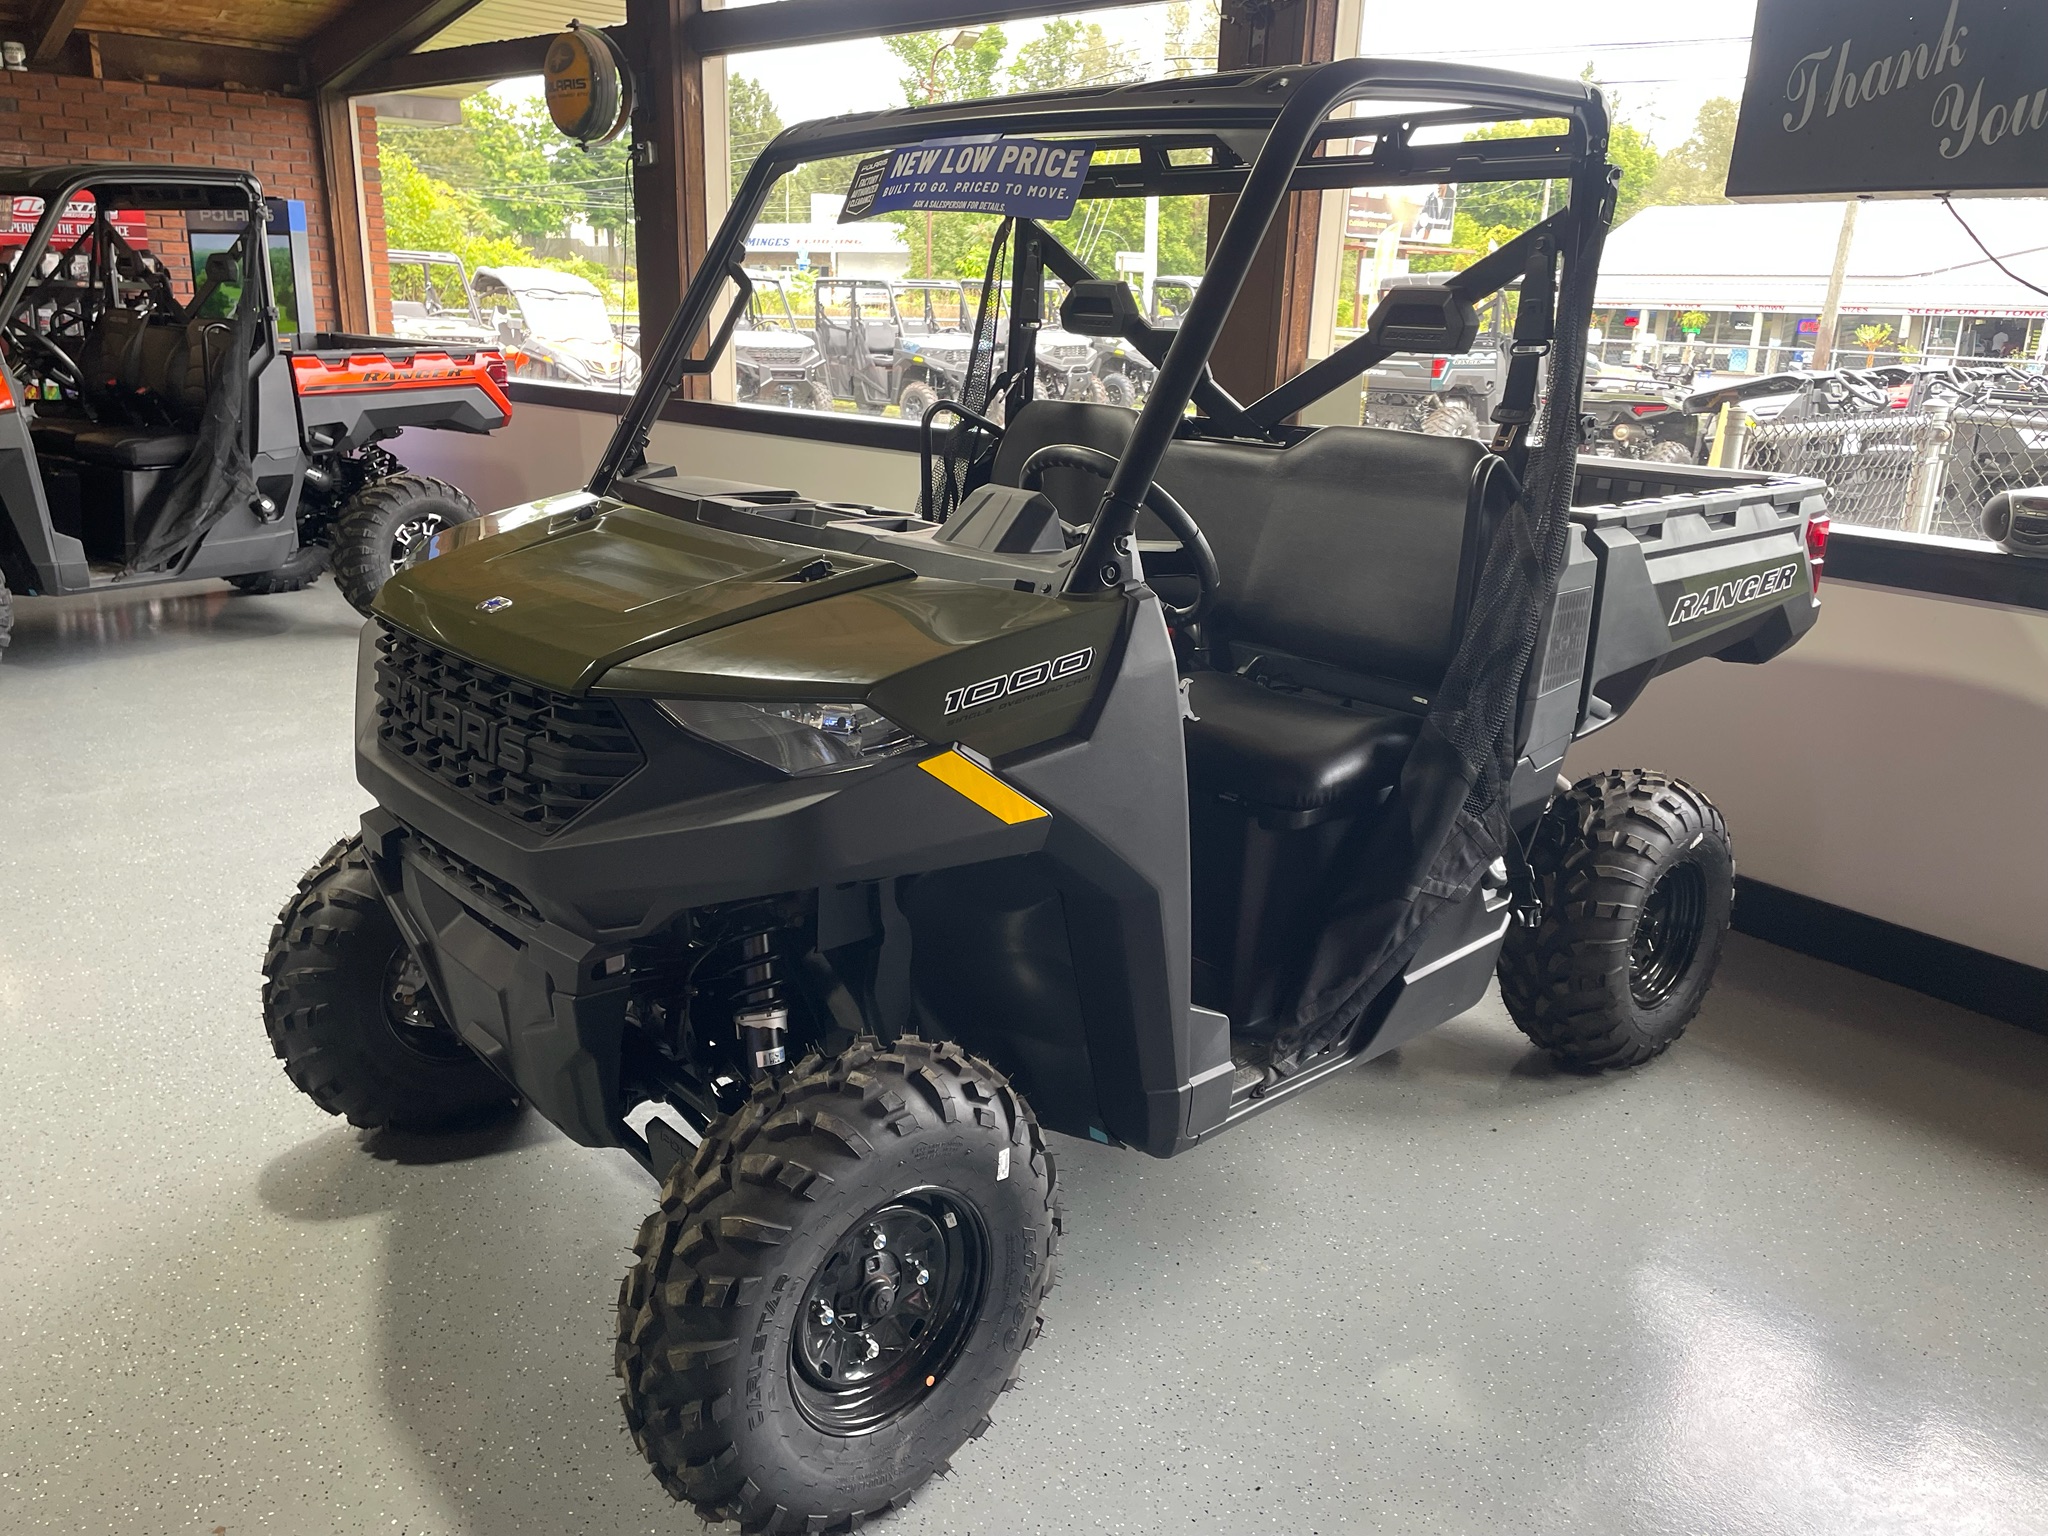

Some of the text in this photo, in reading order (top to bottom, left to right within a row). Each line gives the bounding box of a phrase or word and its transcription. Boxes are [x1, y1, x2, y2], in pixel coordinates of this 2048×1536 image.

[1782, 0, 1968, 132] Thank
[1931, 77, 2048, 159] You
[861, 158, 888, 172] POLARIS
[890, 146, 1085, 178] NEW LOW PRICE
[850, 183, 880, 199] AUTHORIZED
[858, 174, 880, 187] FACTORY
[882, 182, 1069, 200] BUILT TO GO. PRICED TO MOVE.
[912, 200, 924, 208] ASK
[928, 200, 966, 209] SALESPERSON
[979, 202, 1006, 212] DETAILS.
[57, 224, 74, 234] THE
[363, 368, 463, 382] RANGER
[1667, 563, 1798, 626] RANGER
[943, 646, 1097, 715] 1000
[946, 674, 1093, 727] SINGLE OVERHEAD CAM
[376, 664, 531, 775] POLARIS
